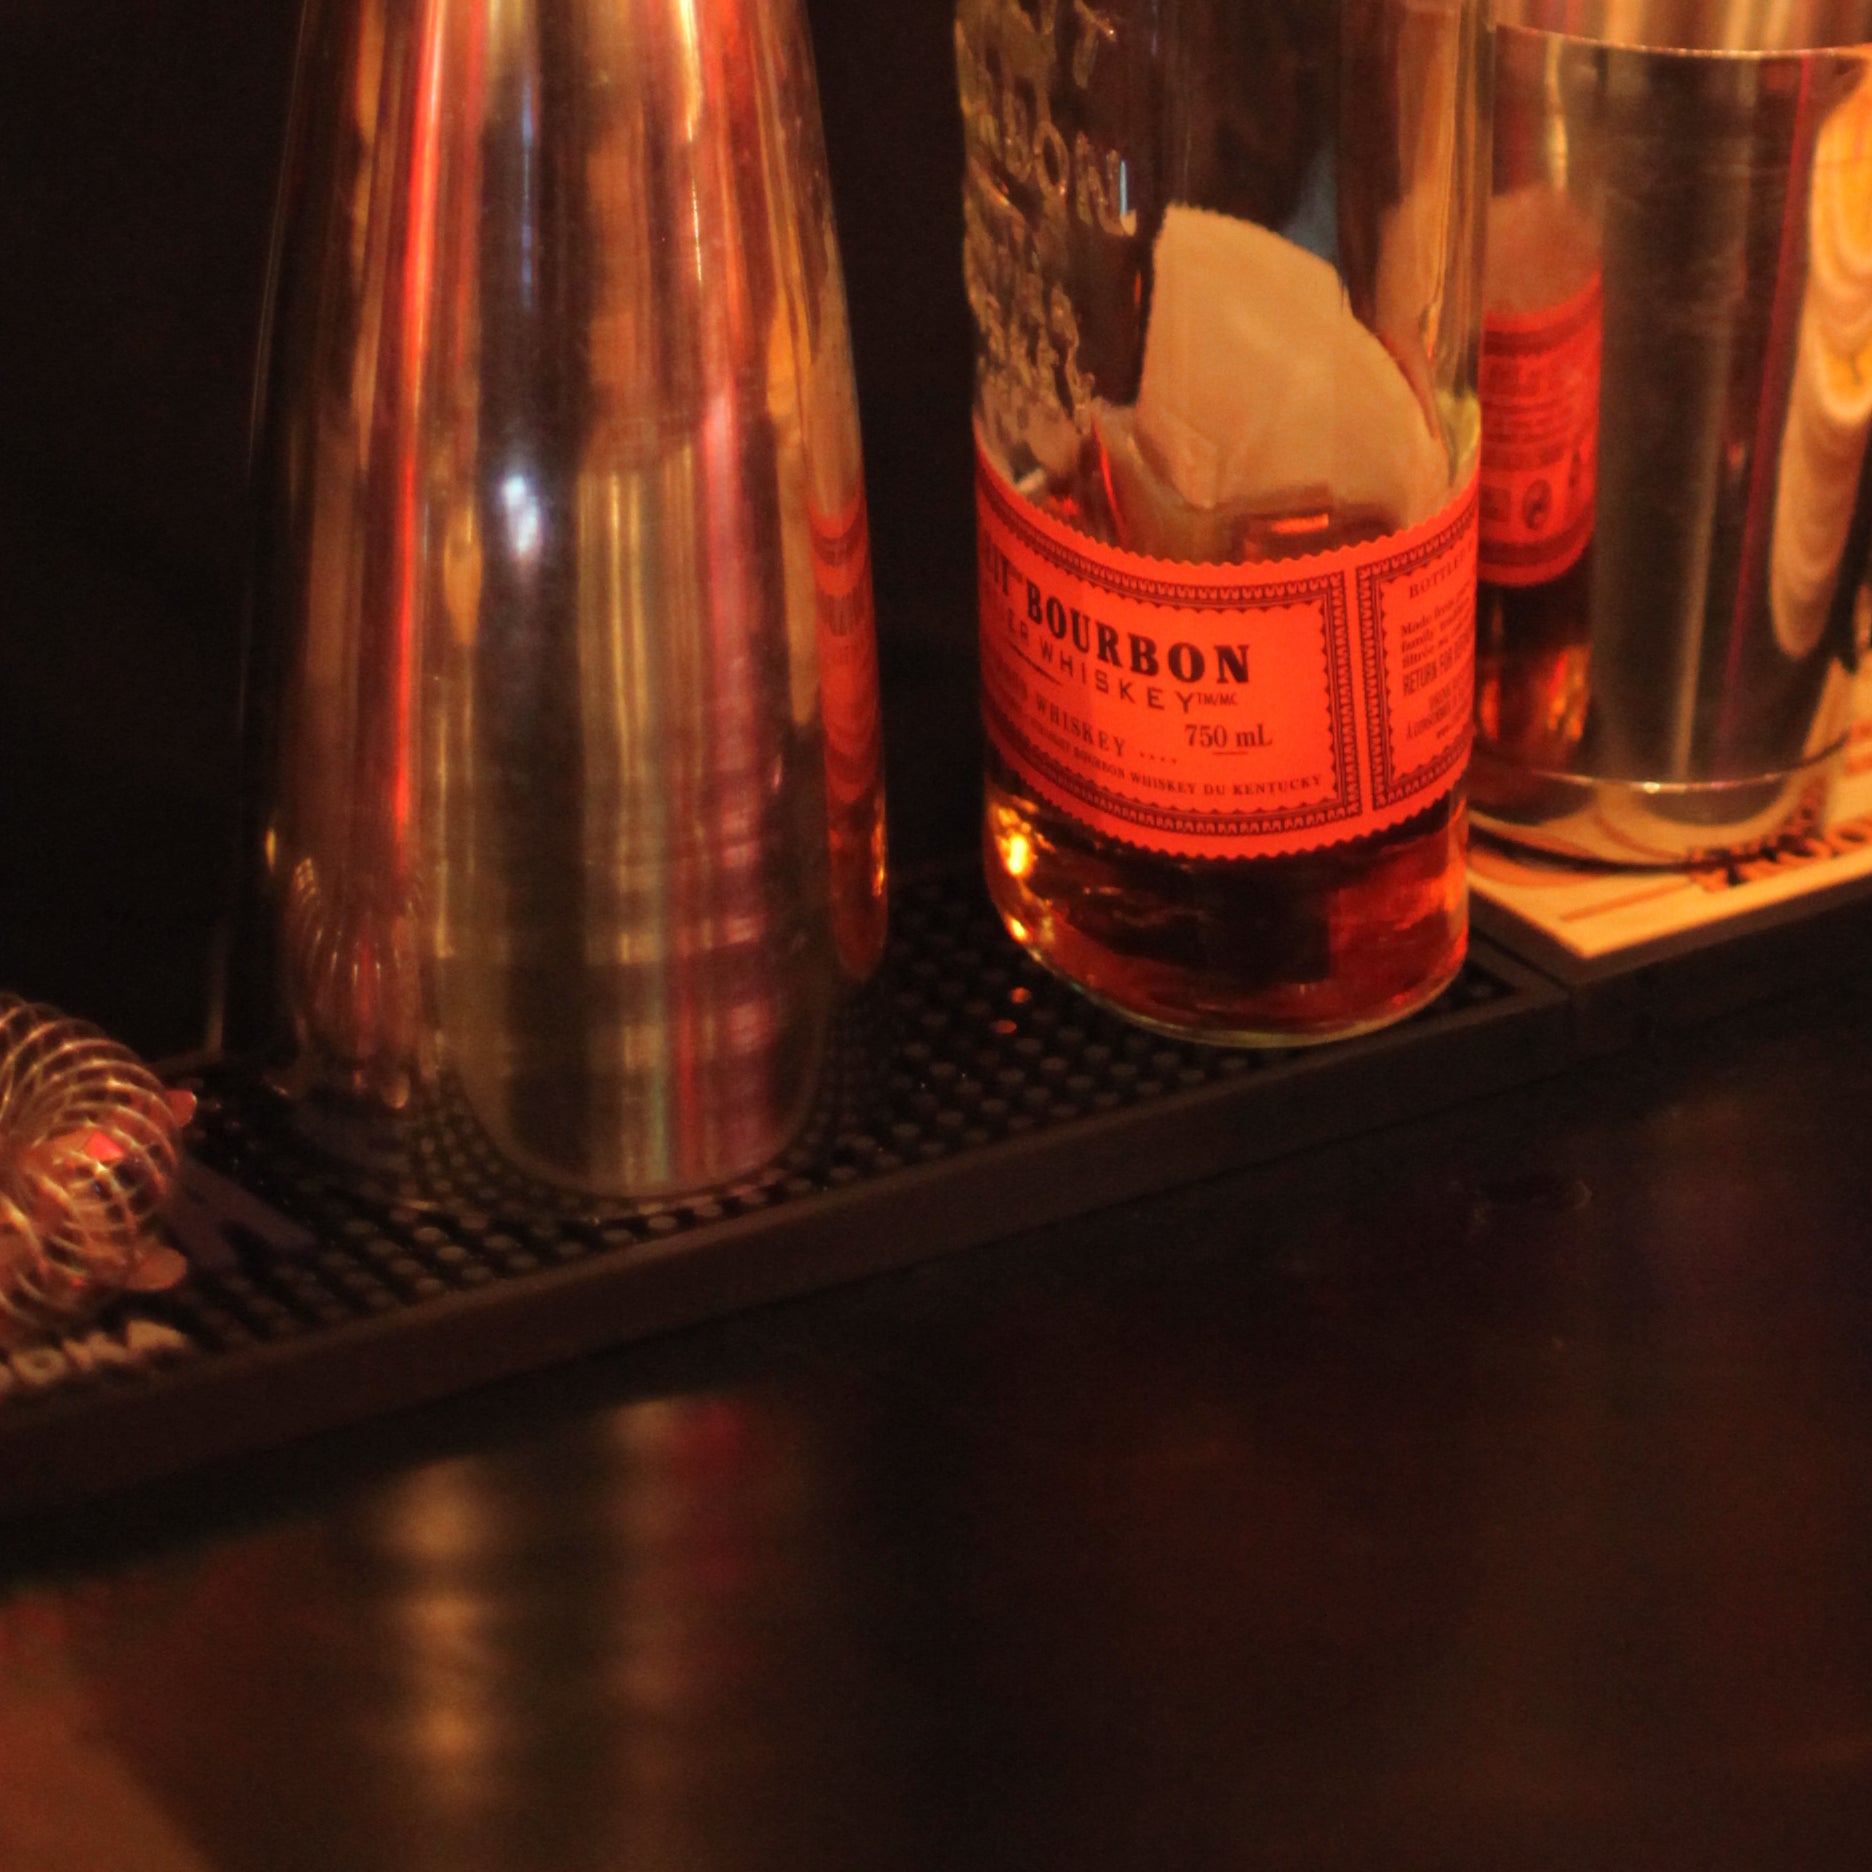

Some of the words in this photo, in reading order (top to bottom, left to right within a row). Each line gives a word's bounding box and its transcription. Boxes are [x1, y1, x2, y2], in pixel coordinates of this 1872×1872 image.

[1026, 577, 1251, 685] BOURBON
[1040, 638, 1195, 715] WHISKEY
[1035, 691, 1126, 758] WHISKEY
[1184, 723, 1228, 749] 750
[1235, 722, 1273, 748] mL
[1130, 768, 1197, 795] WHISKEY
[1203, 782, 1226, 796] DU
[1232, 774, 1321, 797] KENTUCKY
